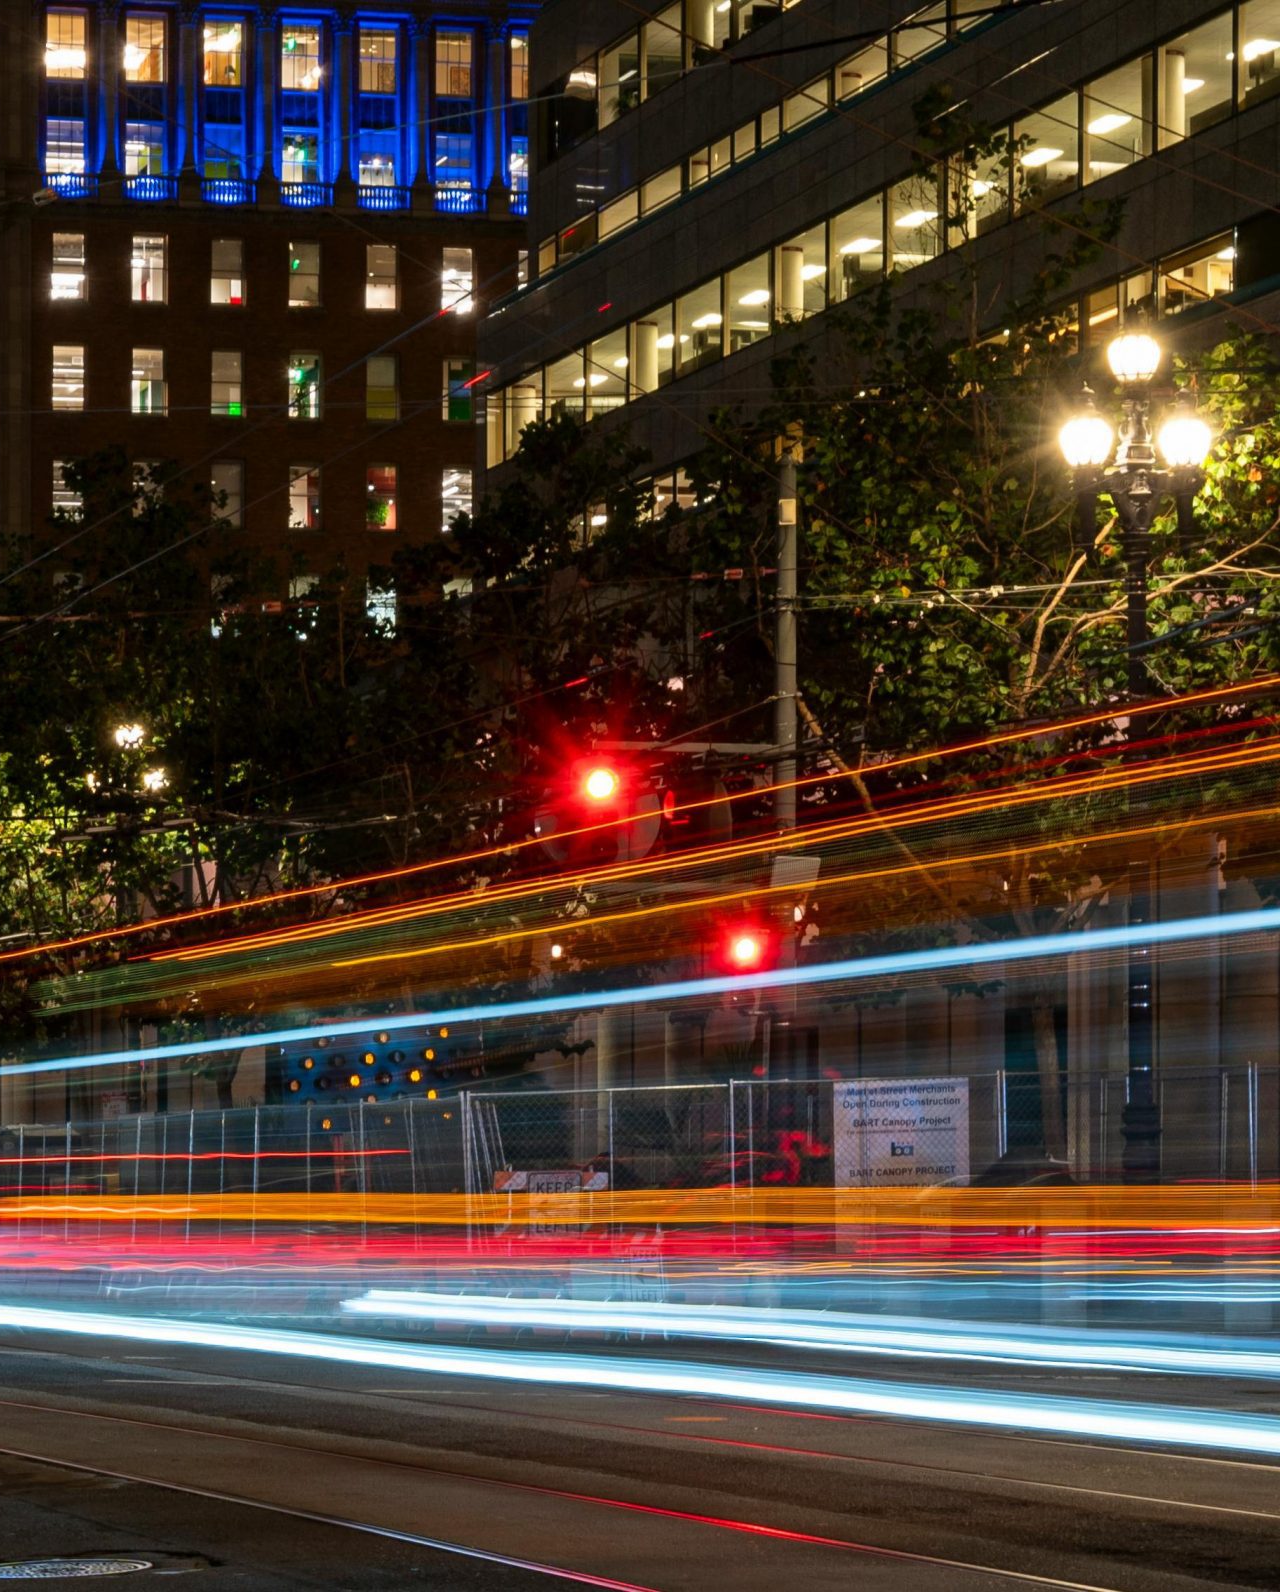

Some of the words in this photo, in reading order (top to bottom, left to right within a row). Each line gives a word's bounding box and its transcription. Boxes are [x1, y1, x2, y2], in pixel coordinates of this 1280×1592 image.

[880, 1086, 908, 1095] Street
[910, 1085, 956, 1094] Merchants
[843, 1100, 867, 1110] Open
[870, 1099, 900, 1109] During
[903, 1097, 961, 1107] Construction
[853, 1118, 879, 1128] BART
[882, 1118, 917, 1127] Canopy
[919, 1116, 951, 1126] Project
[849, 1168, 874, 1178] BART
[876, 1167, 913, 1177] CANOPY
[915, 1165, 957, 1175] PROJECT
[536, 1181, 573, 1194] KEEP
